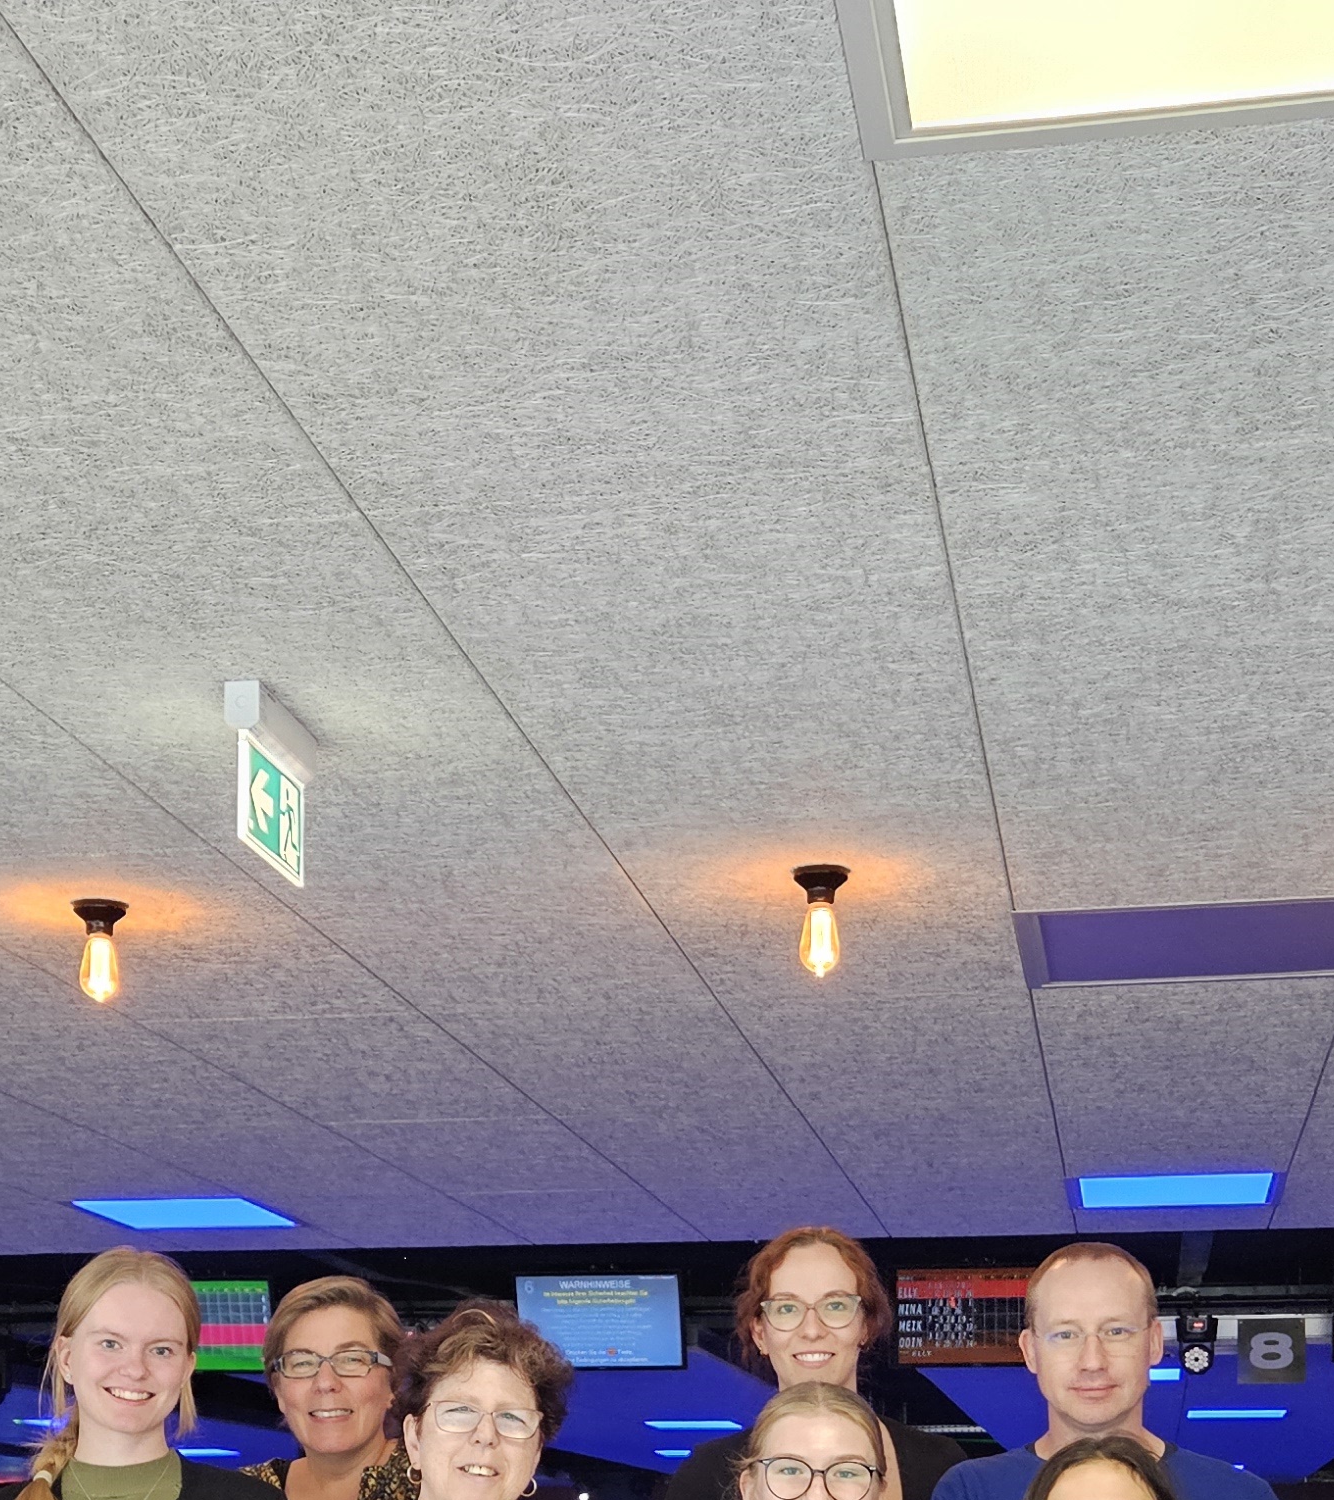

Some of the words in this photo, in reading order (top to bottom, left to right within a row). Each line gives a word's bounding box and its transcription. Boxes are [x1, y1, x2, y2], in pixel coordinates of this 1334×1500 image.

[524, 1281, 534, 1294] 6
[559, 1280, 631, 1289] WARNHINWEISE
[898, 1287, 918, 1298] ELLY
[898, 1303, 923, 1315] NINA
[898, 1320, 922, 1332] MEIK
[1249, 1332, 1294, 1370] 8
